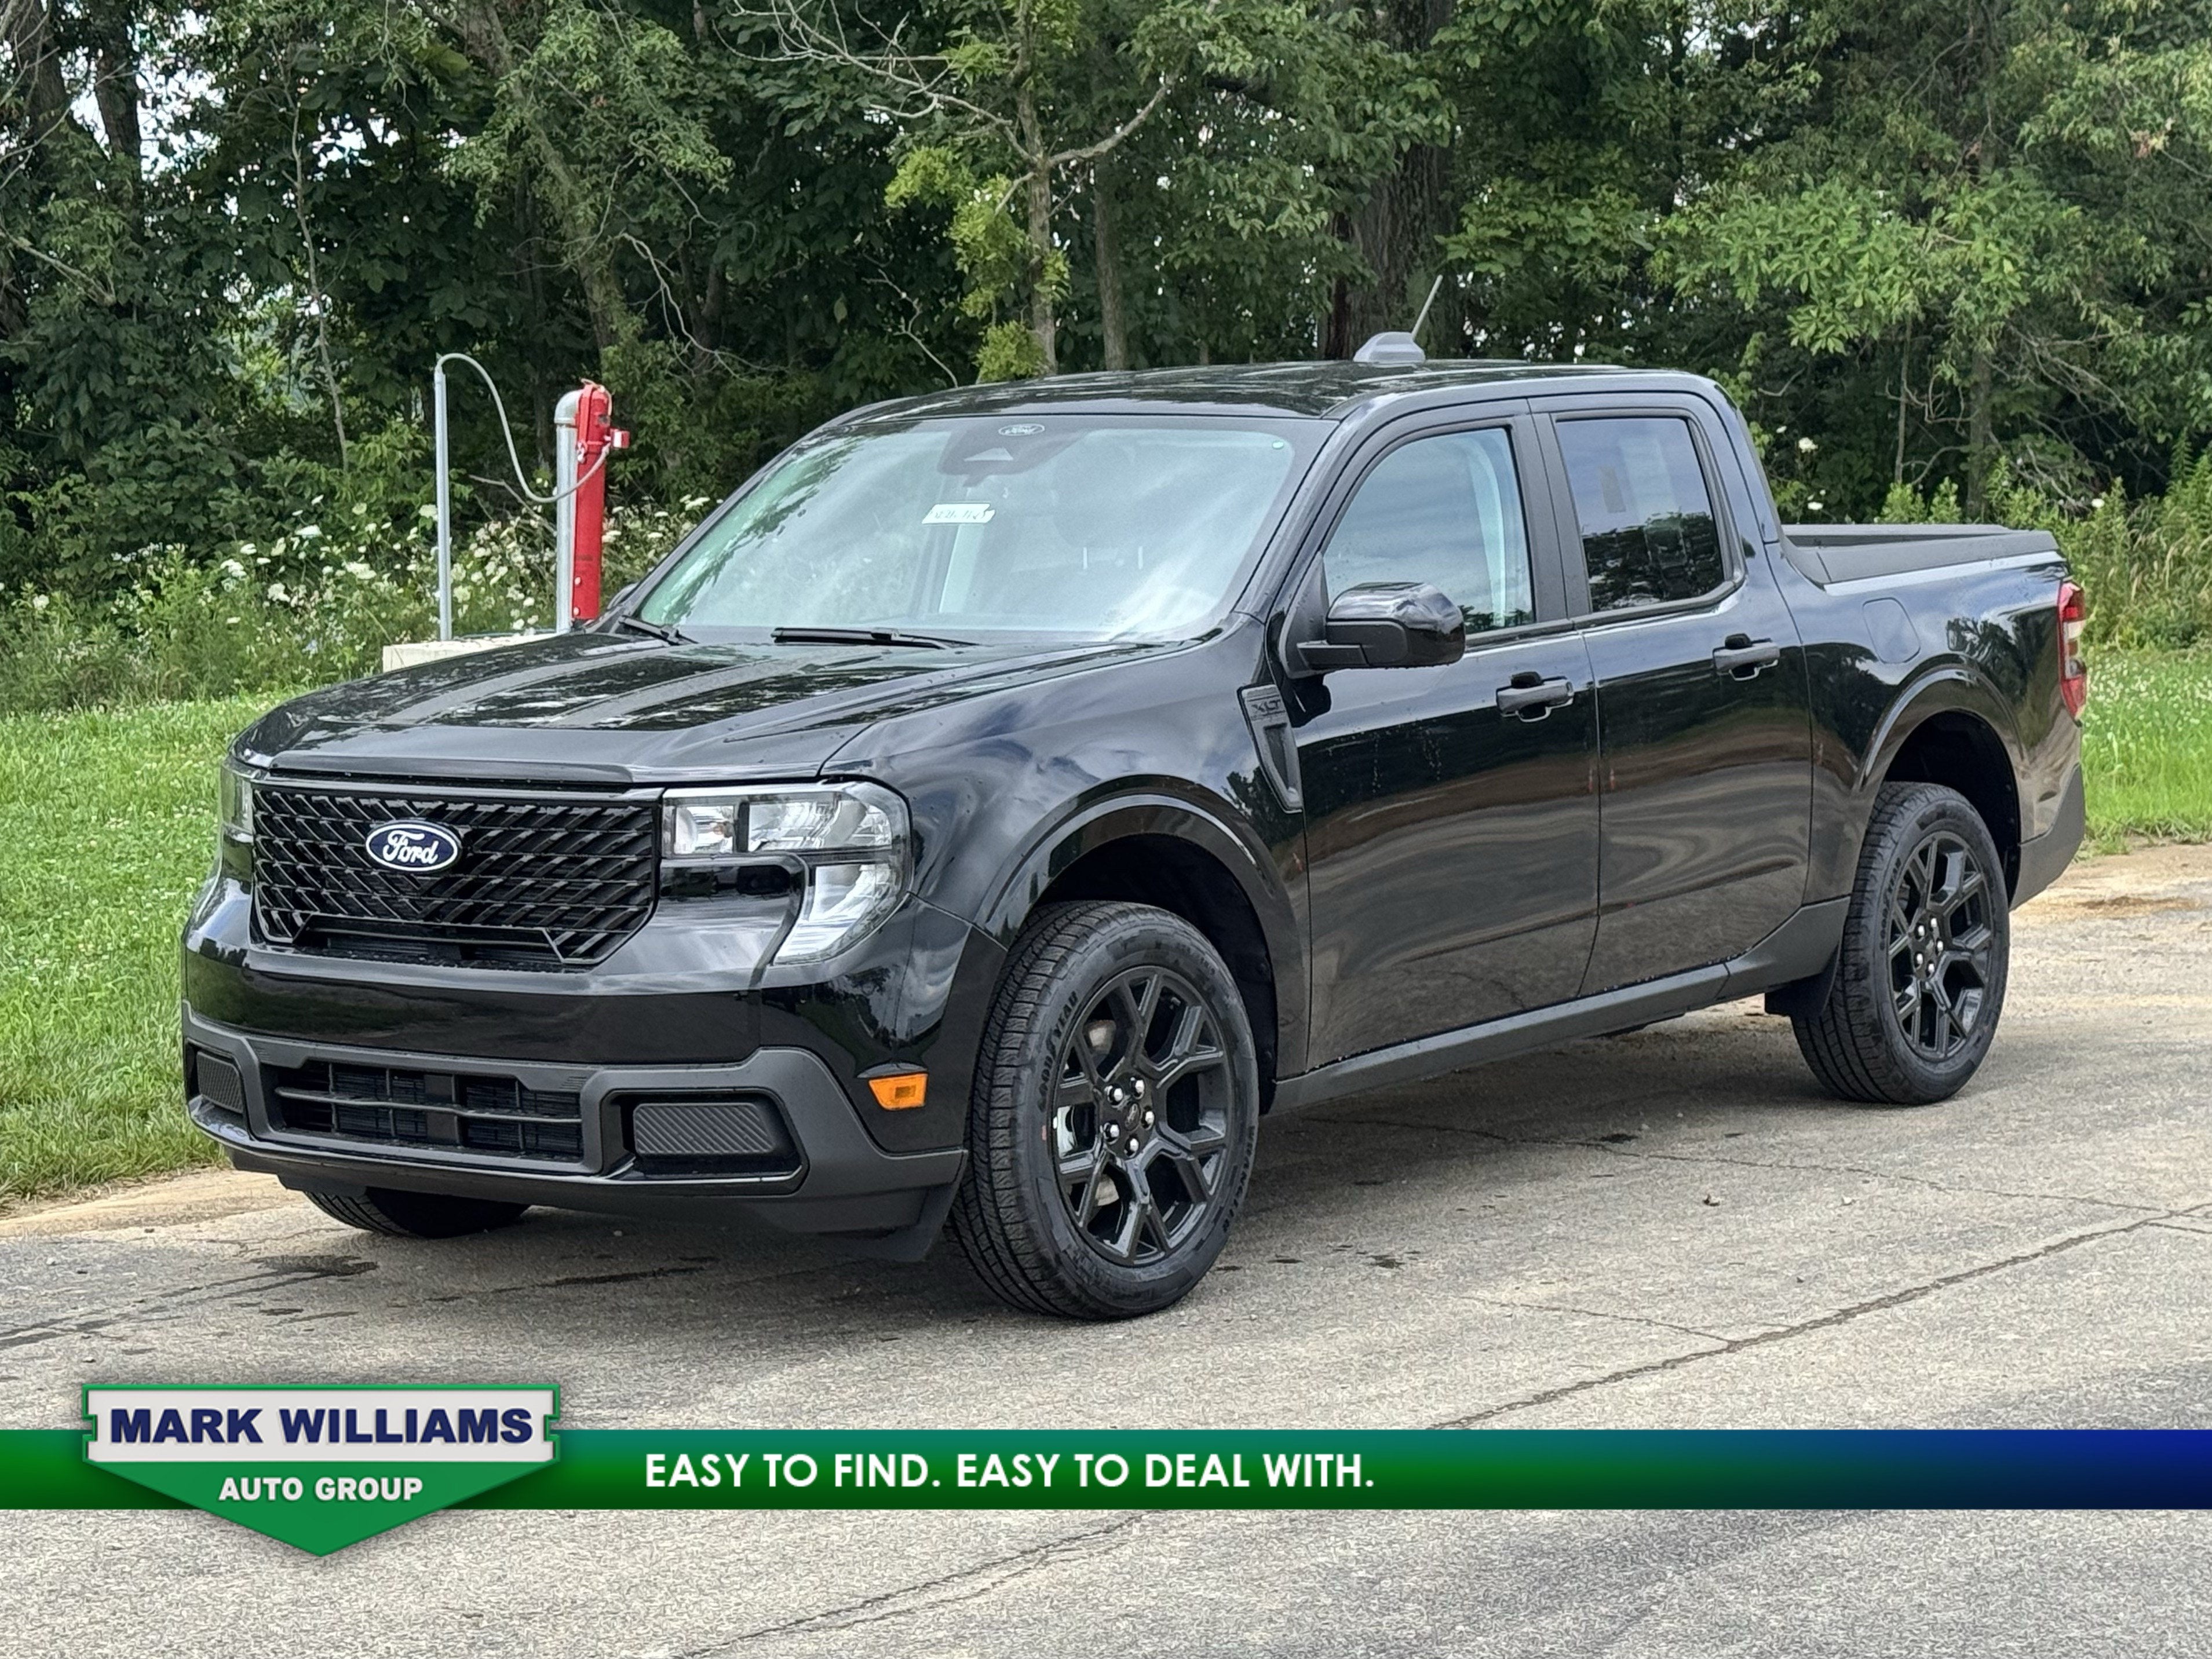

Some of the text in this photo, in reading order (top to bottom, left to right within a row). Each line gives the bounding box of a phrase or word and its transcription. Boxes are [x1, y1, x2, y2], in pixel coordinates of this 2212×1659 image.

[1251, 699, 1280, 712] XLT
[382, 830, 439, 864] Ford
[1037, 991, 1078, 1112] GOODYEAR
